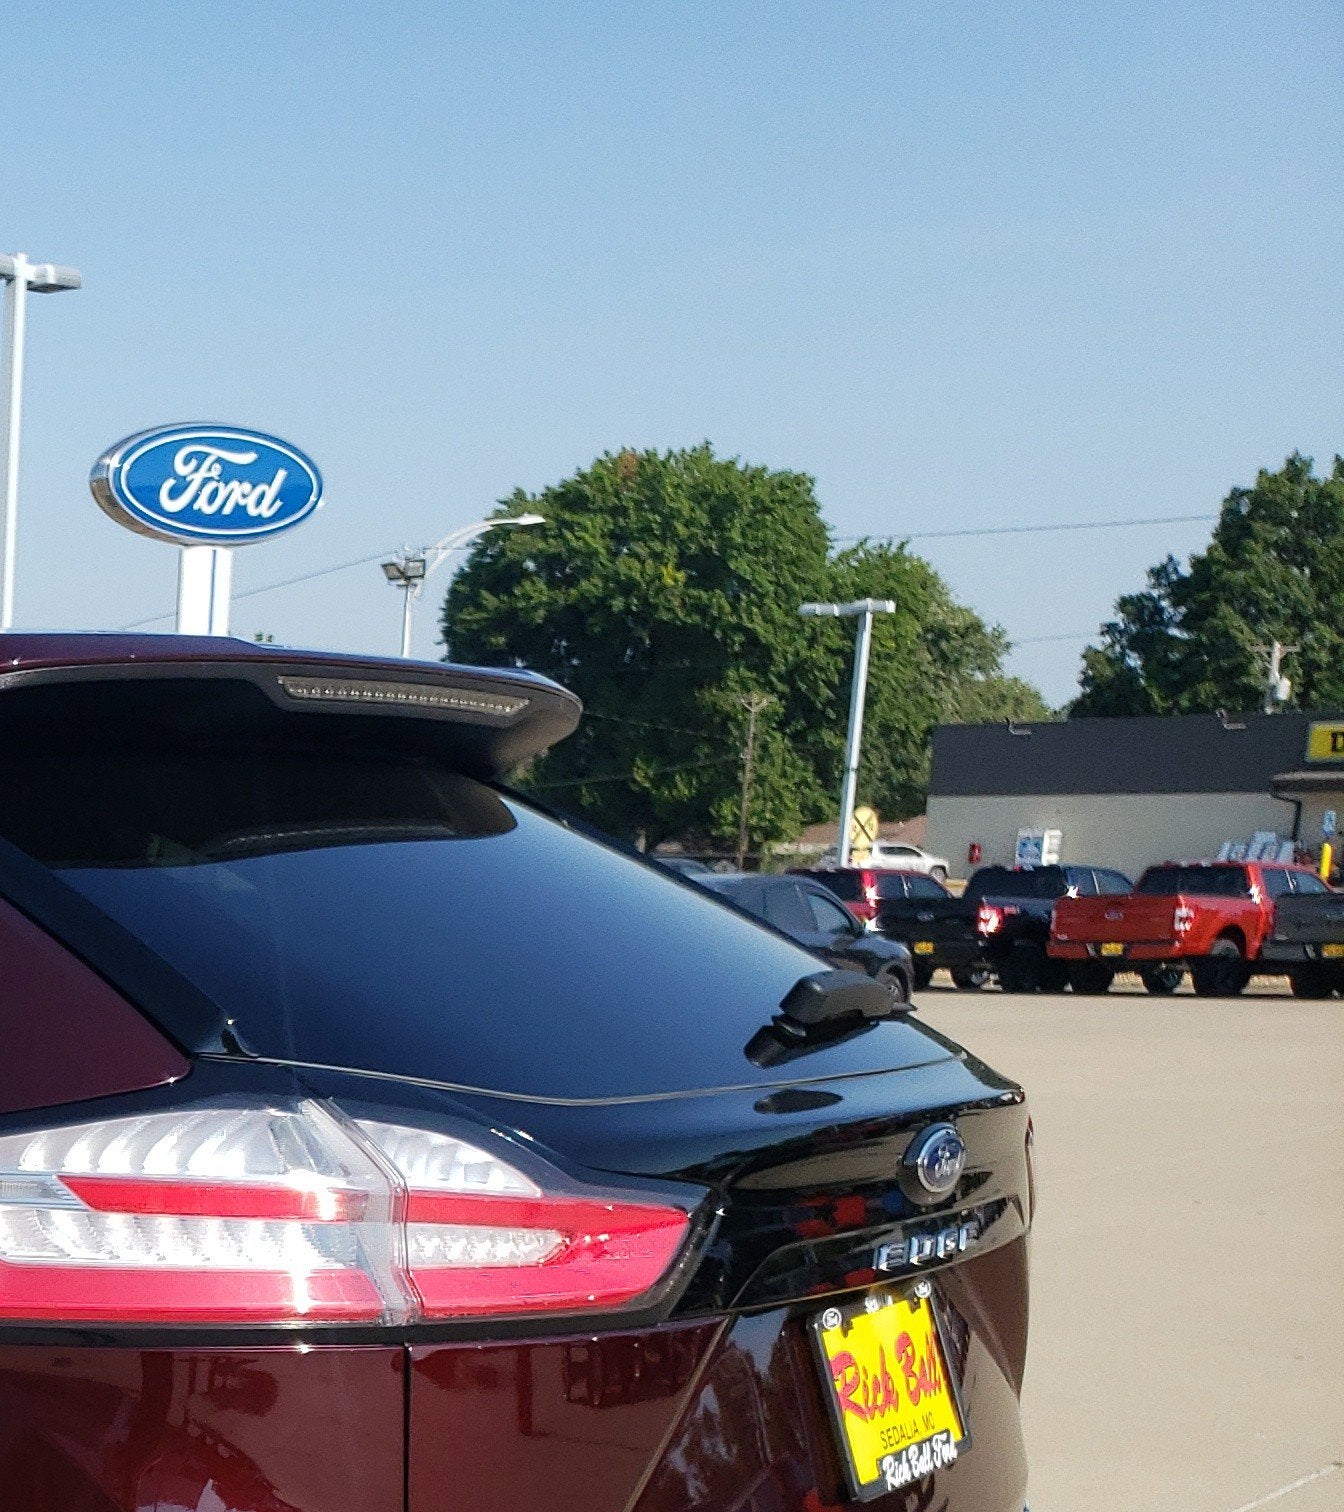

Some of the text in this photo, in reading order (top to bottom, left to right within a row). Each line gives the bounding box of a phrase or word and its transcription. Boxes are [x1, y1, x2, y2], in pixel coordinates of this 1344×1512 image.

[159, 444, 288, 519] Ford
[873, 1221, 980, 1271] EDGE
[829, 1331, 942, 1423] Rick Ball
[882, 1453, 913, 1491] Rick
[908, 1446, 935, 1478] Ball
